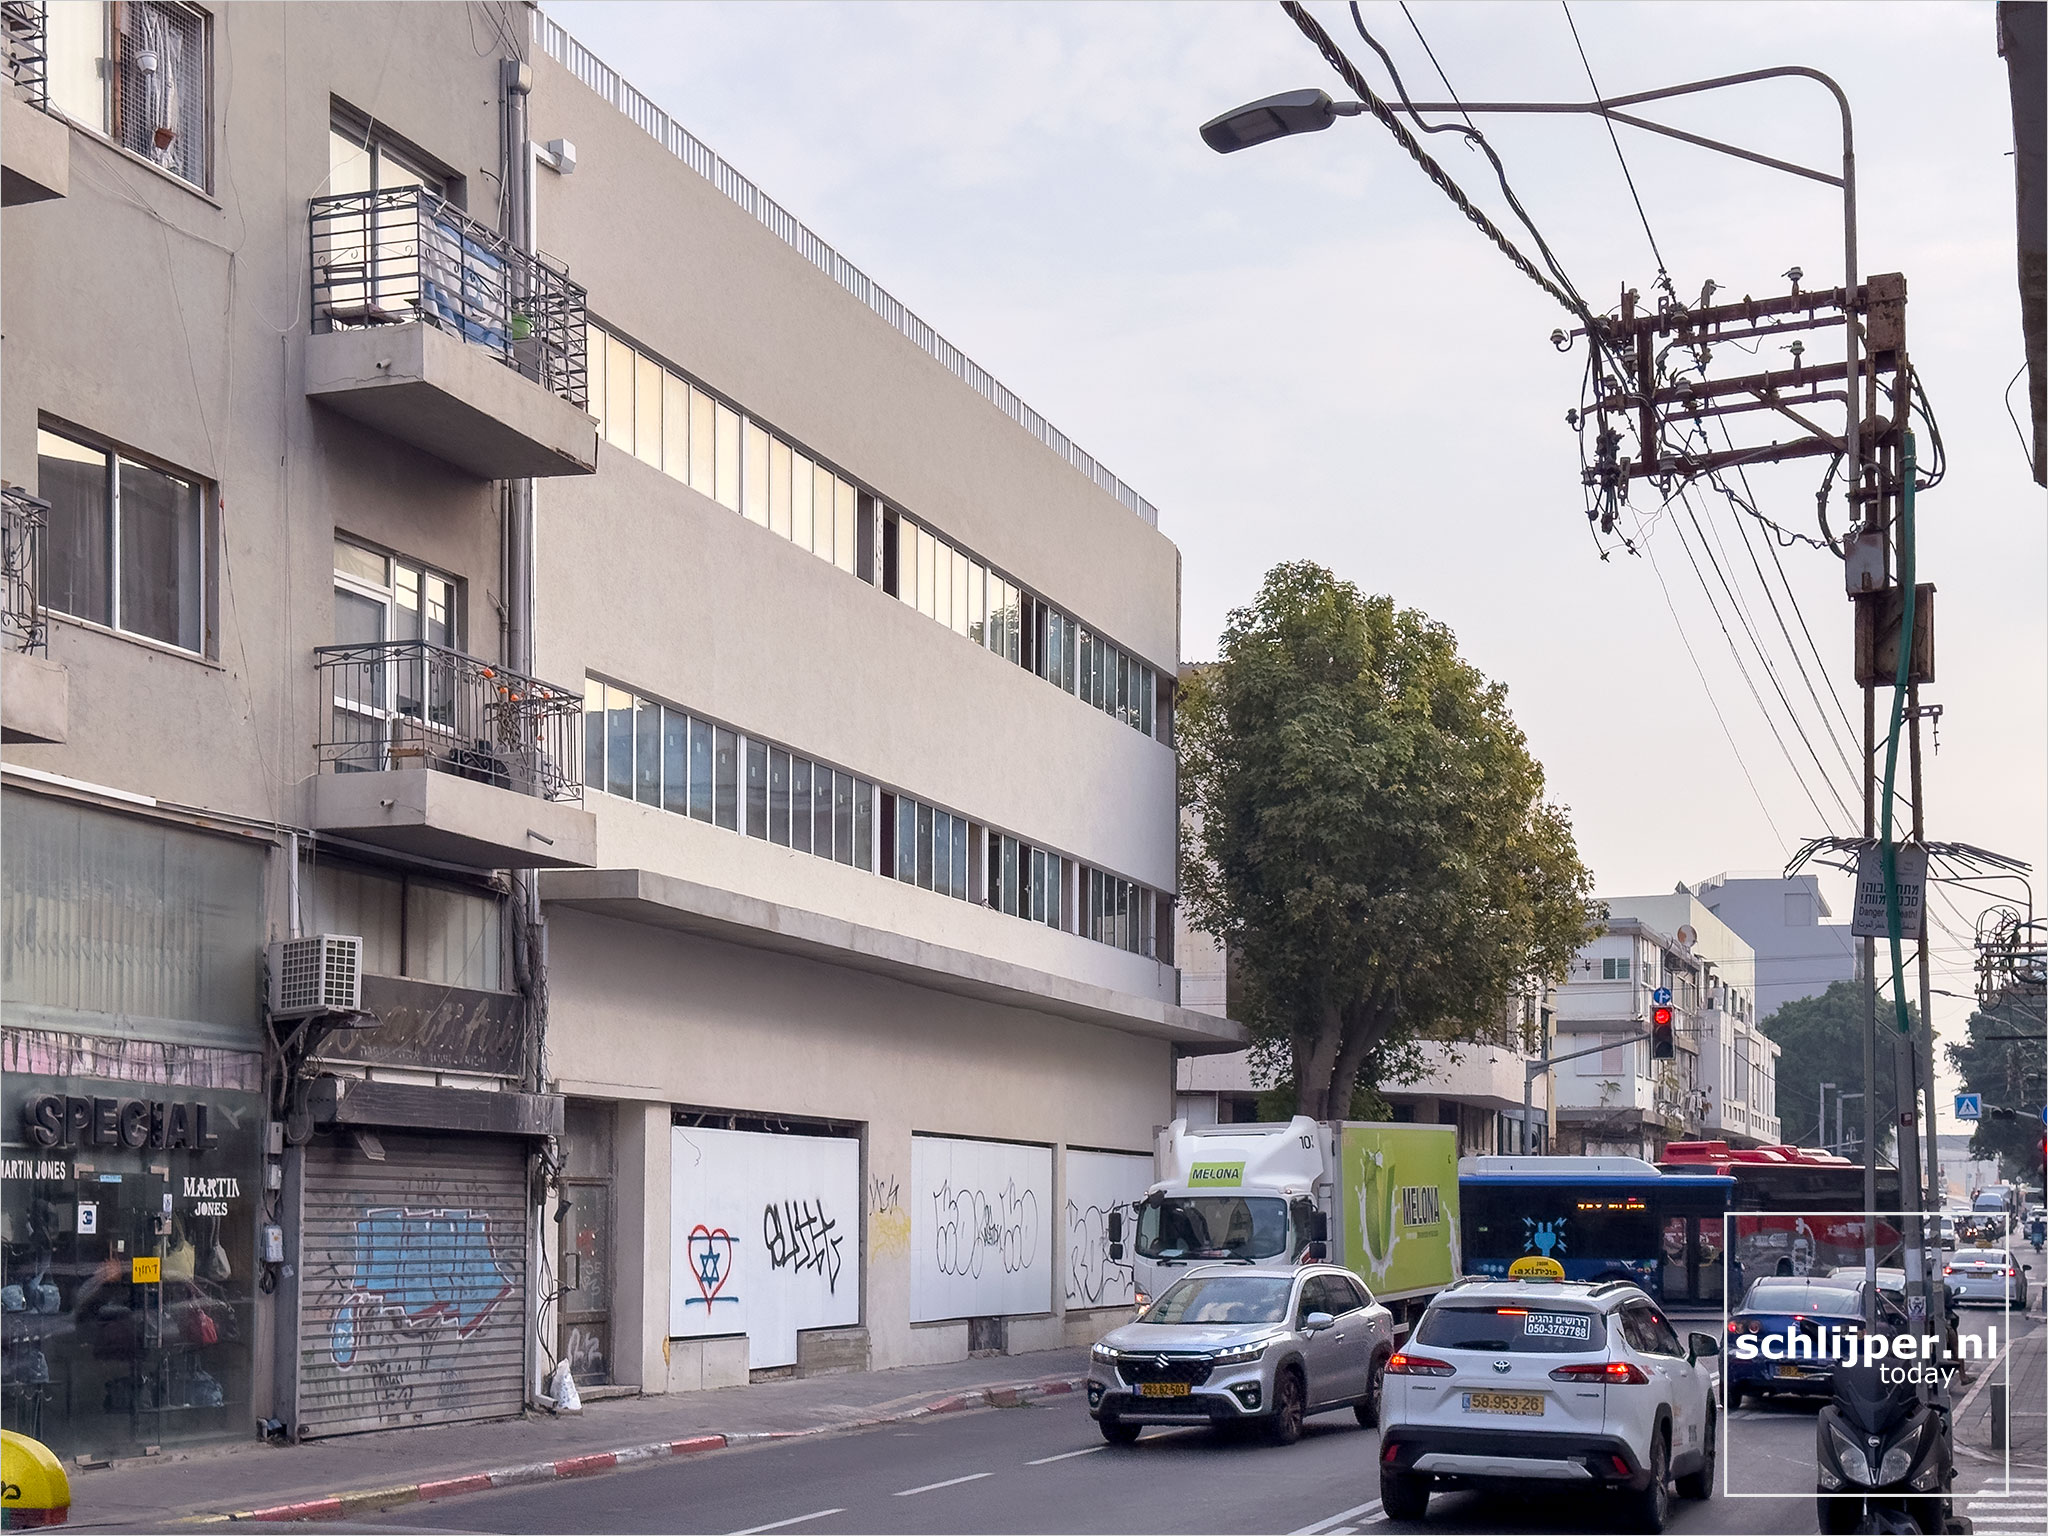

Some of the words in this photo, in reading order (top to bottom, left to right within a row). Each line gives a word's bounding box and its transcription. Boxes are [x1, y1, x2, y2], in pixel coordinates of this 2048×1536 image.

[1862, 882, 1887, 893] בוה!
[1897, 895, 1919, 907] סכנ
[1858, 906, 1885, 919] Danger
[28, 1093, 218, 1148] SPECIAL
[35, 1160, 66, 1180] JONES
[1192, 1168, 1240, 1180] MELONA
[183, 1176, 240, 1199] MARTIN
[194, 1201, 228, 1217] JONES
[1402, 1186, 1440, 1226] MELONA
[1528, 1315, 1553, 1324] נהגים
[1556, 1316, 1587, 1327] דרושים
[1527, 1324, 1587, 1337] 050-3767788
